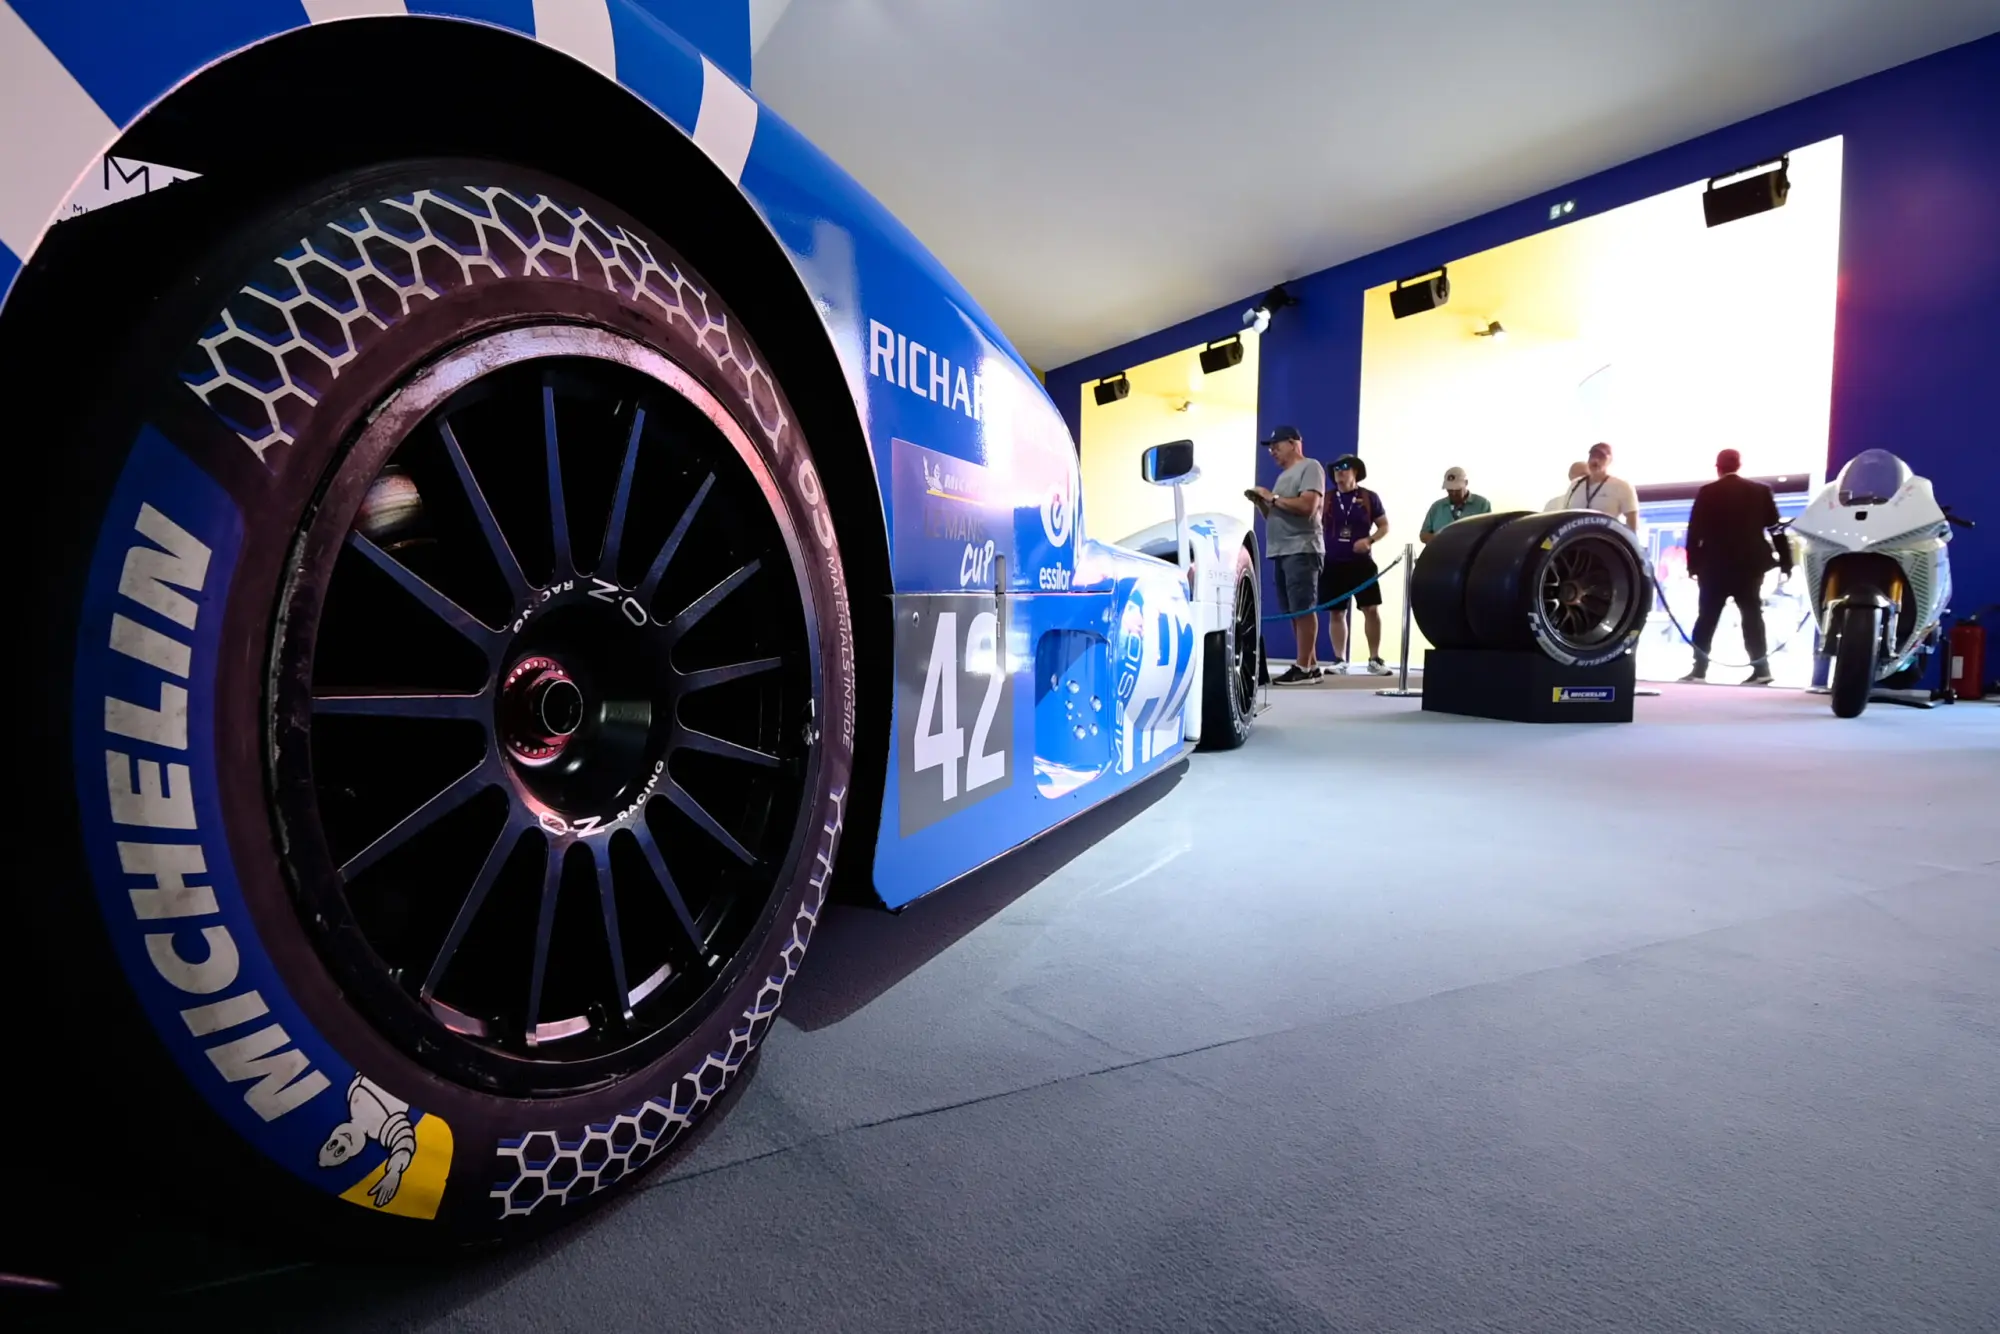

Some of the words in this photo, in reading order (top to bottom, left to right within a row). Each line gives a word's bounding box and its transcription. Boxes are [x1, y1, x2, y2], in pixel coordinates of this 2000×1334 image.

[944, 511, 985, 543] MANS
[1558, 516, 1608, 534] MICHELIN
[960, 539, 994, 587] CUP
[1039, 561, 1071, 590] essilor
[513, 579, 574, 634] RACNG
[826, 555, 851, 672] MATERIALS
[842, 676, 852, 750] INSIDE
[914, 612, 1005, 802] 42
[1114, 630, 1142, 776] MISSIO
[104, 501, 332, 1123] MICHELIN
[616, 760, 665, 822] RACING
